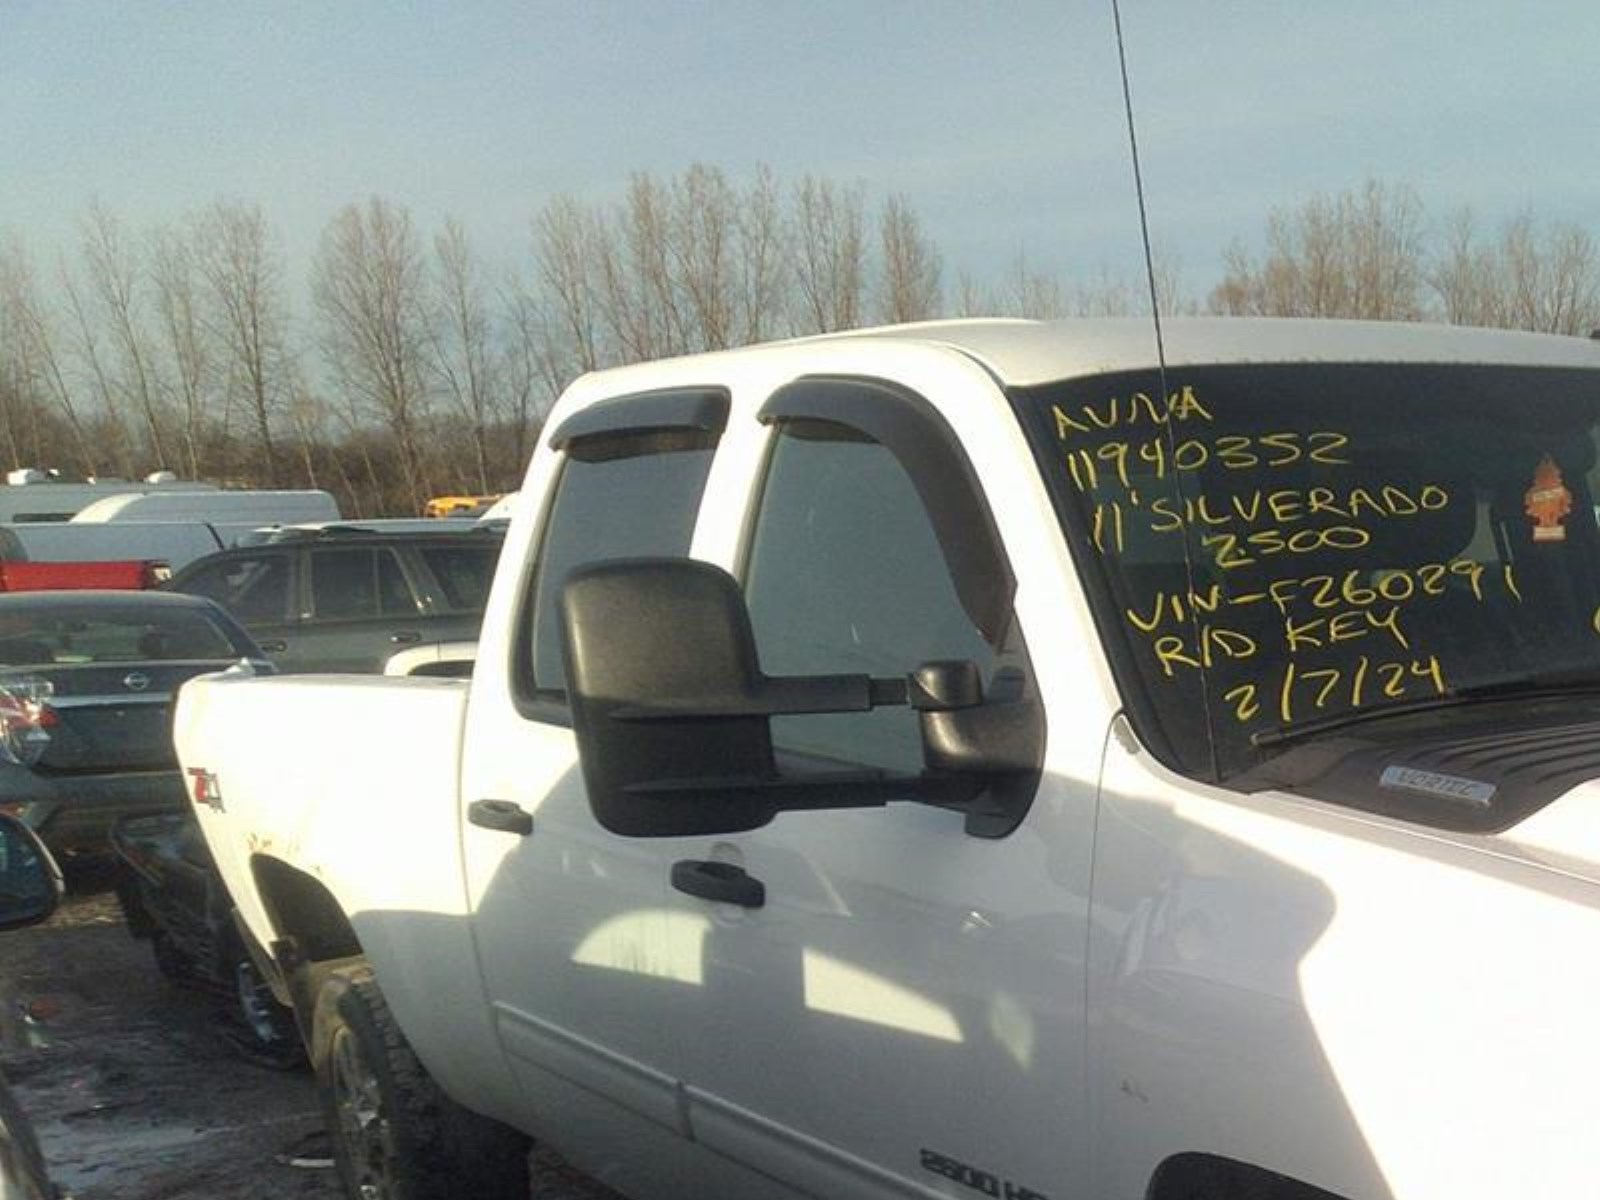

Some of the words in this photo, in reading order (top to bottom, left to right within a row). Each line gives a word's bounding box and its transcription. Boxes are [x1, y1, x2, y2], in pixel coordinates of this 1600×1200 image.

[1068, 431, 1350, 493] 11940352
[1151, 485, 1449, 532] SILVERADO
[1201, 526, 1370, 568] 2500
[1285, 606, 1409, 653] KEY
[1224, 654, 1446, 722] 2/7/24
[920, 1148, 1000, 1199] 2500
